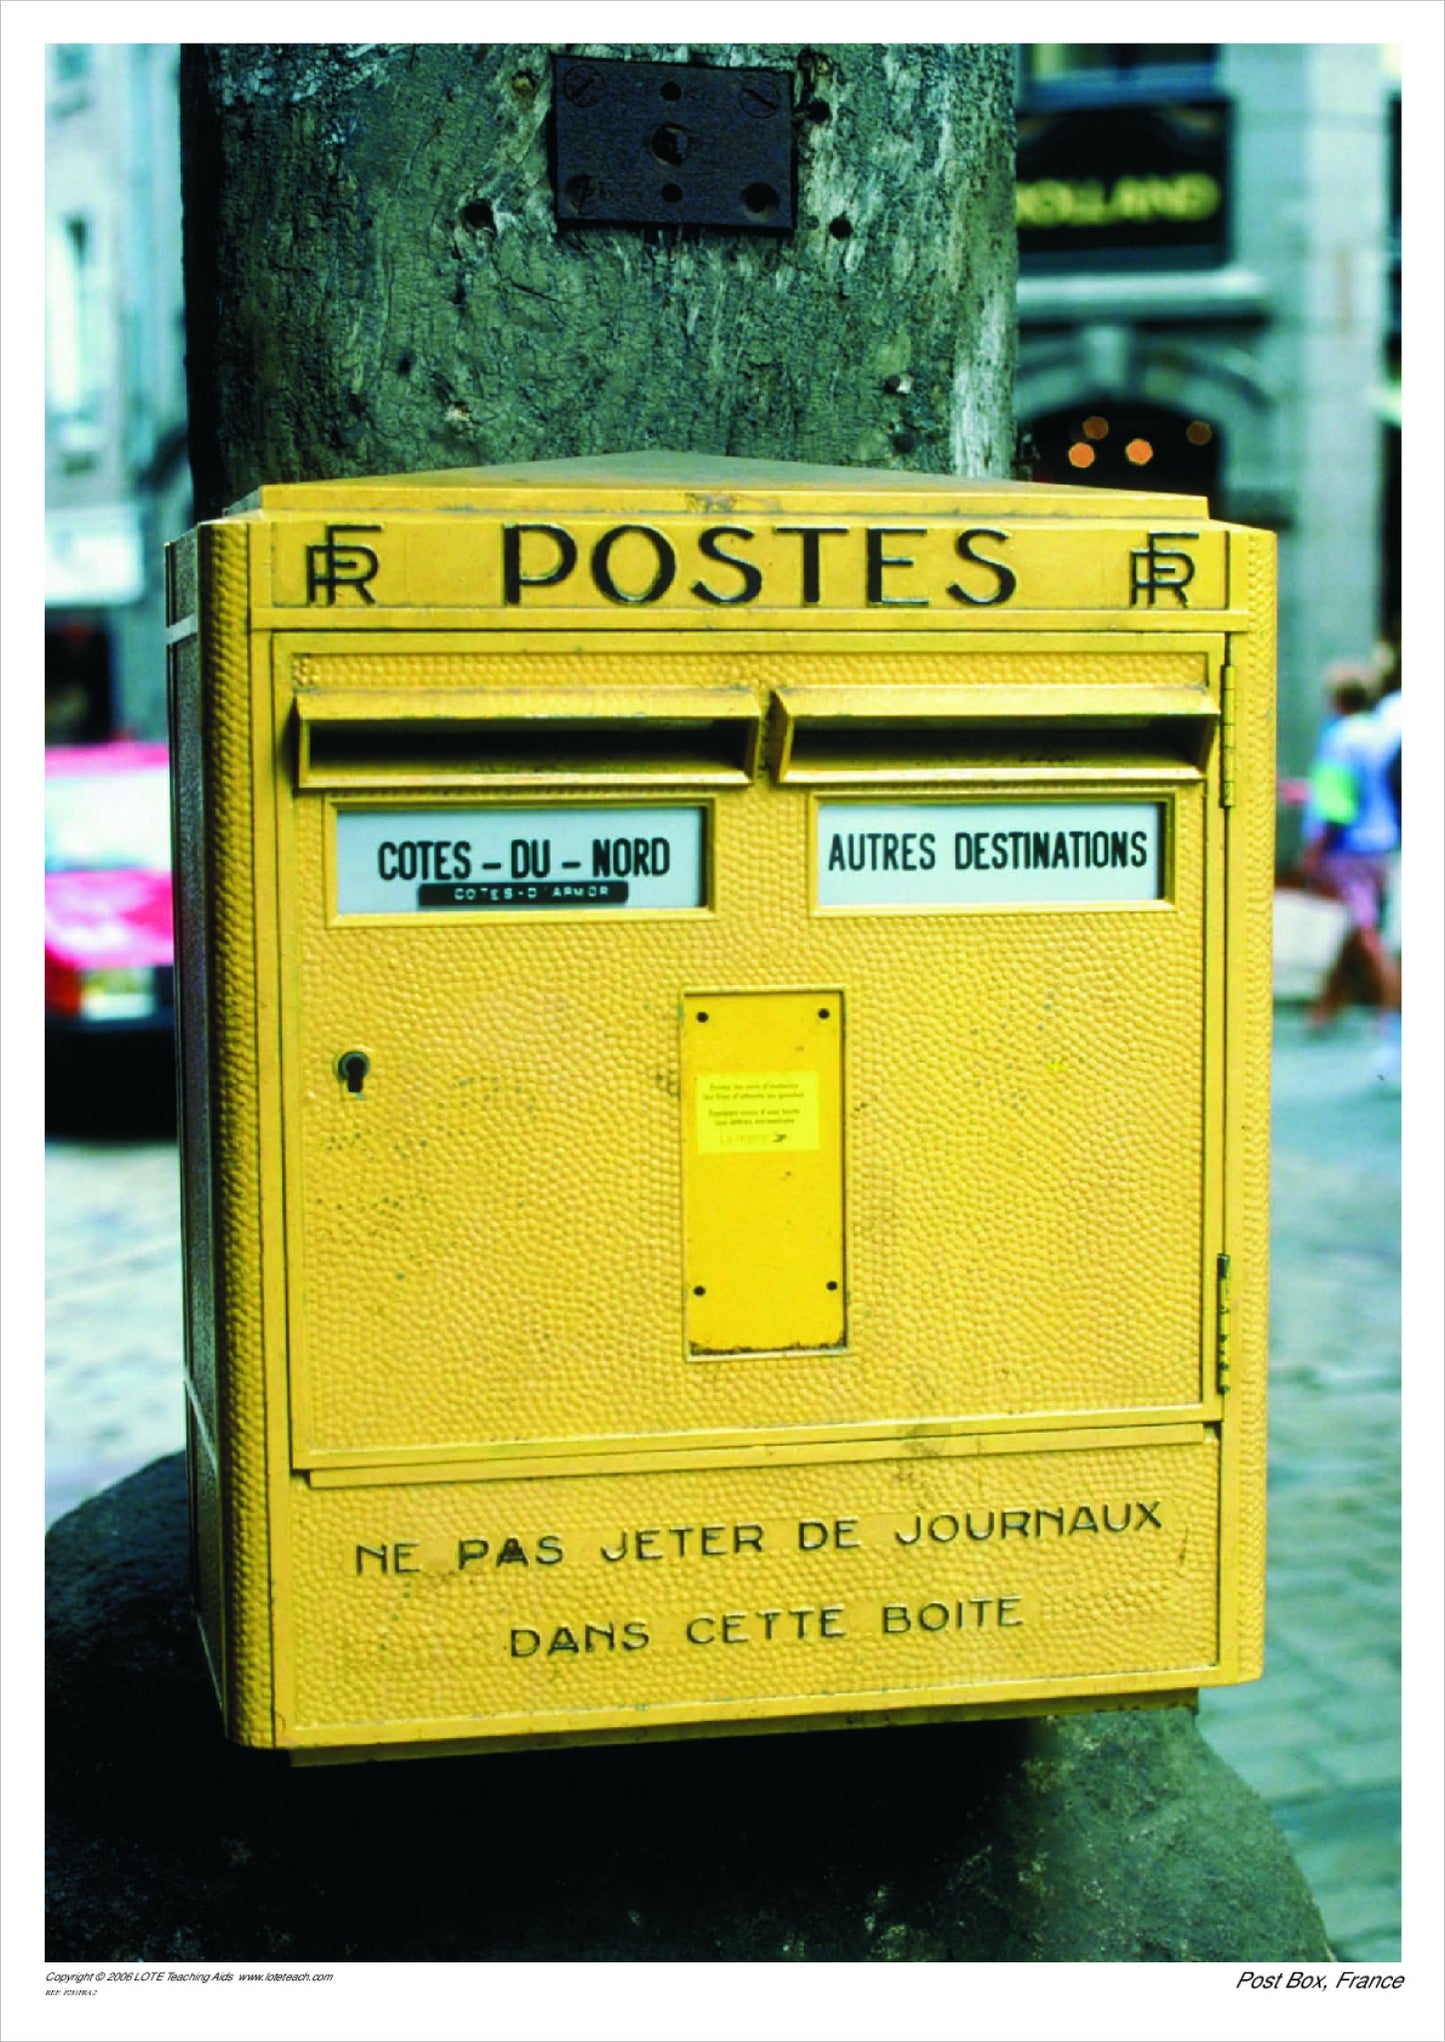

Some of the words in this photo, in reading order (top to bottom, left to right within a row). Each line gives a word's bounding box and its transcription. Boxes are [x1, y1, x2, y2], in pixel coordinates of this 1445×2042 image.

[502, 523, 1018, 606] POSTES
[377, 840, 472, 881] COTES
[510, 839, 551, 880] DU
[592, 837, 670, 878] NORD
[828, 833, 936, 871] AUTRES
[954, 831, 1147, 870] DESTINATIONS
[356, 1541, 422, 1576] NE
[457, 1535, 565, 1571] PAS
[600, 1523, 765, 1562] JETER
[799, 1518, 860, 1551] DE
[896, 1501, 1163, 1545] JOURNAUX
[509, 1621, 651, 1657] DANS
[686, 1604, 846, 1644] CETTE
[883, 1596, 1024, 1634] BOITE
